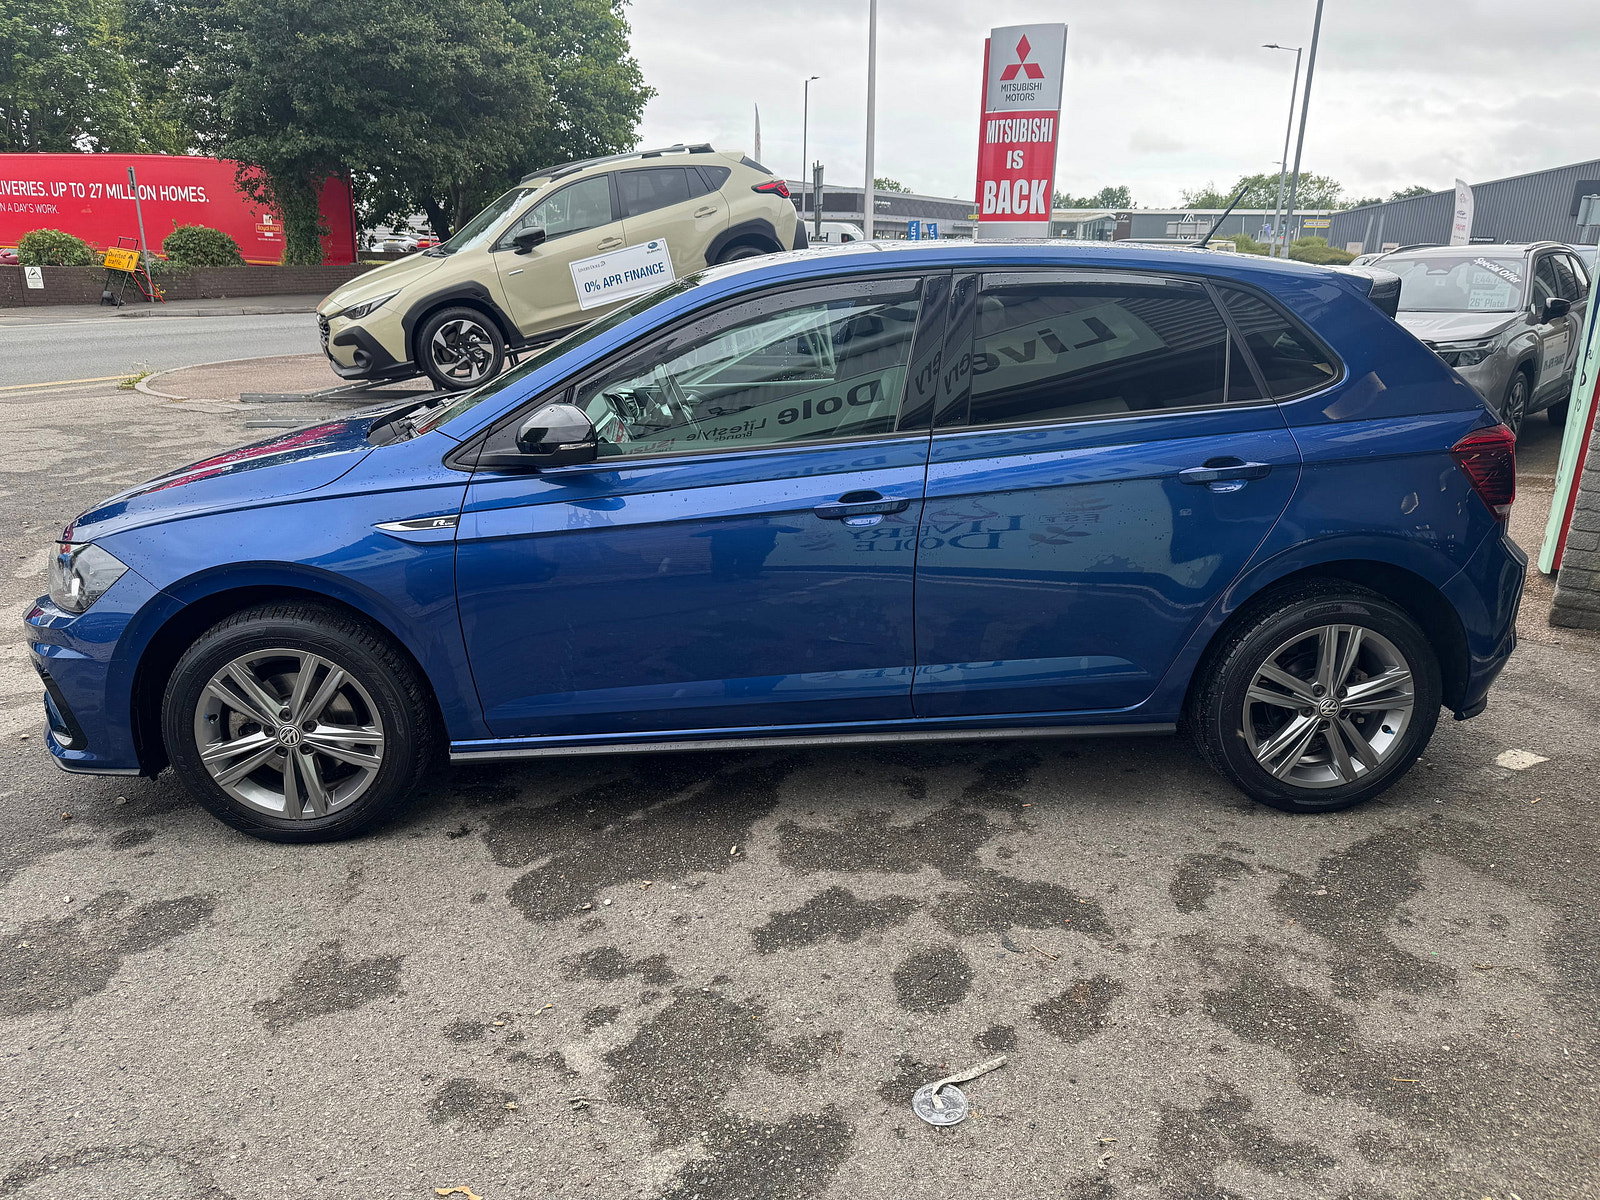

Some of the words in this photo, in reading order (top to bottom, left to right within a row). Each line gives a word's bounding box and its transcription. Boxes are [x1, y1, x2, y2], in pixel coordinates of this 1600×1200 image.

[1001, 83, 1042, 92] MITSUBISHI
[1005, 93, 1035, 102] MOTORS
[986, 118, 1054, 144] MITSUBISHI
[1006, 150, 1024, 169] IS
[50, 182, 67, 197] UP
[69, 182, 86, 198] TO
[89, 183, 103, 199] 27
[105, 183, 157, 201] MILLON
[160, 185, 210, 203] HOMES.
[982, 179, 1048, 215] BACK
[14, 202, 34, 213] DAY'S
[35, 204, 60, 214] WORK.
[584, 280, 601, 293] 0%
[603, 273, 623, 288] APR
[624, 262, 665, 282] FINANCE
[1473, 258, 1503, 272] Special
[1499, 270, 1521, 283] Offer
[1484, 297, 1505, 307] Plate
